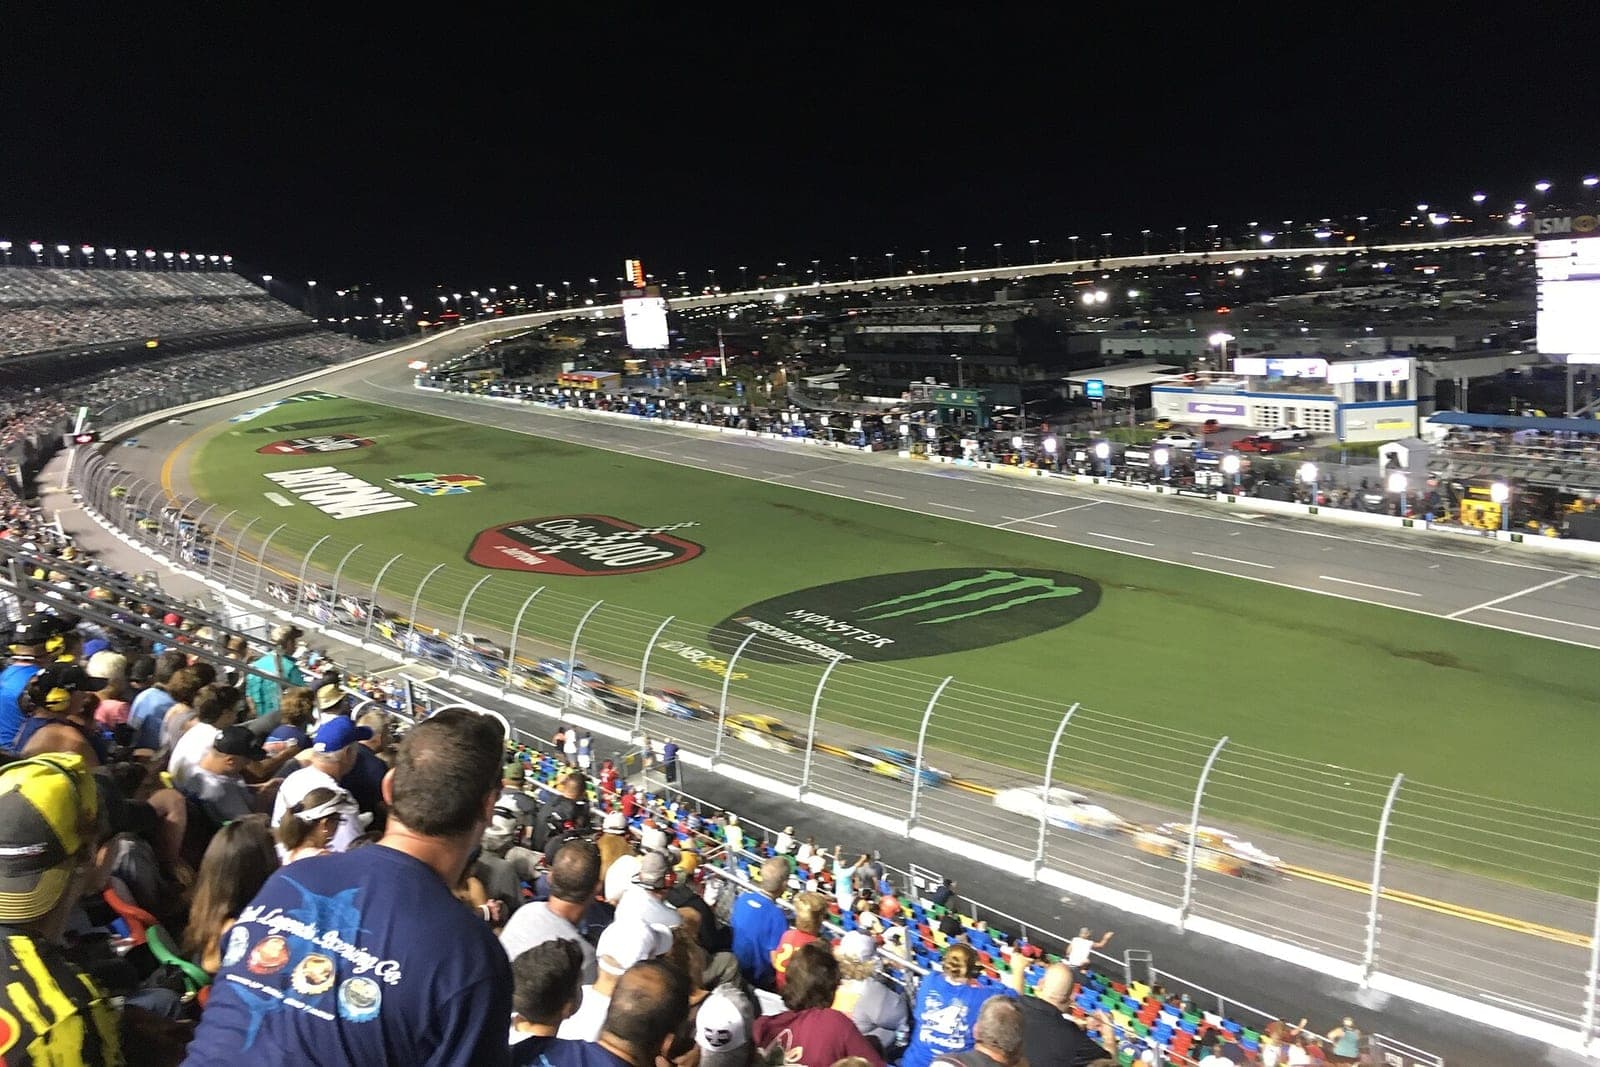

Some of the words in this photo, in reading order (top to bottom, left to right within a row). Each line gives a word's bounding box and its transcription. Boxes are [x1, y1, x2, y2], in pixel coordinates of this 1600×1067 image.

[1533, 217, 1571, 234] ISM
[263, 466, 418, 519] DAYTONA
[534, 519, 599, 540] Coke
[776, 943, 800, 973] 2
